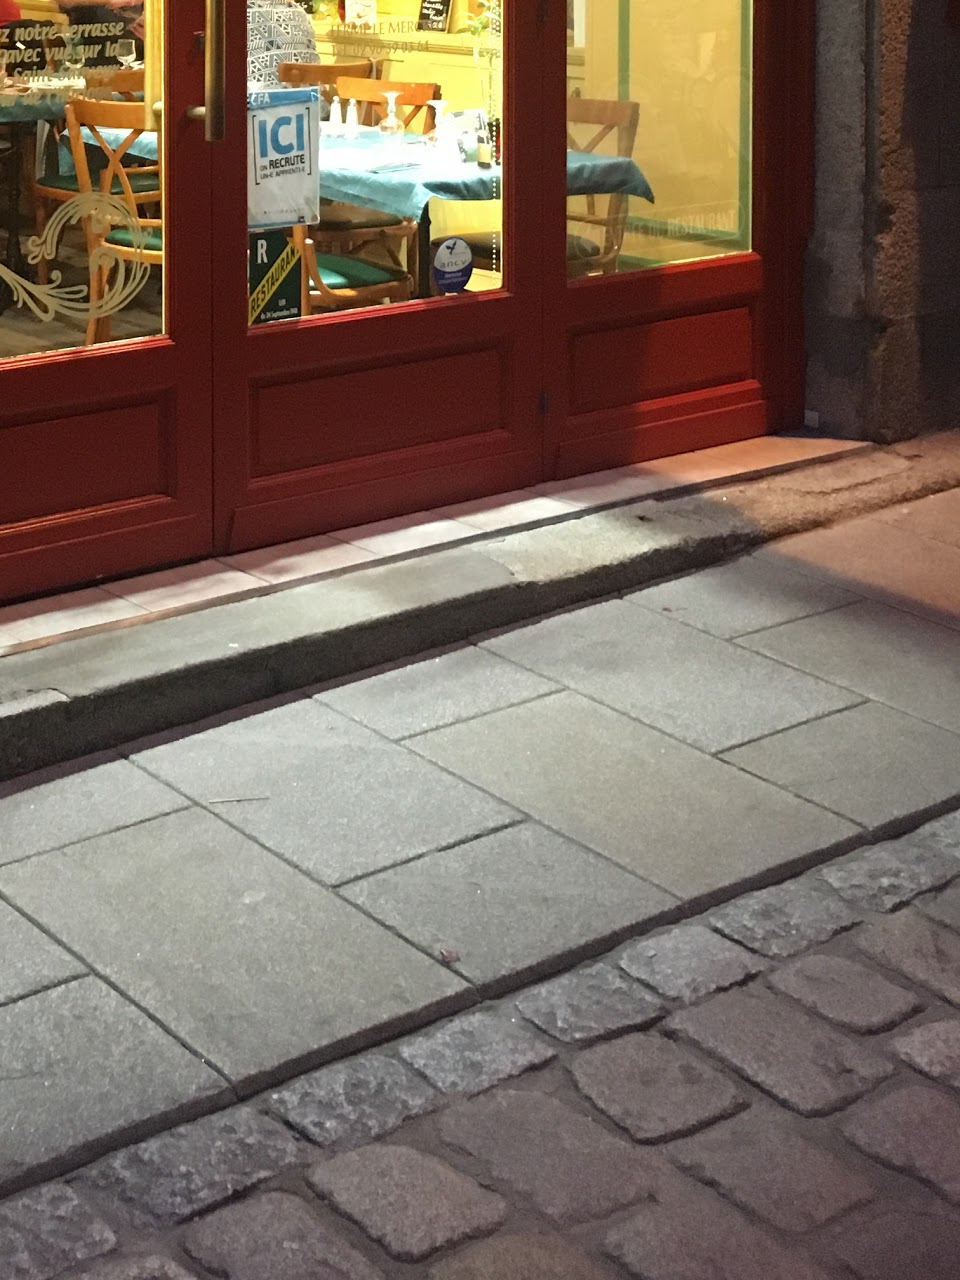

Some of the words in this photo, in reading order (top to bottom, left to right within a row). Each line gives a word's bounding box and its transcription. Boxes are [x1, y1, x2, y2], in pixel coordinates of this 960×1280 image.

[14, 24, 57, 42] notre
[7, 48, 42, 64] avec
[46, 46, 69, 61] vue
[258, 113, 306, 158] ICI
[268, 153, 306, 170] RECRUTE
[250, 246, 300, 318] RESTAURAN
